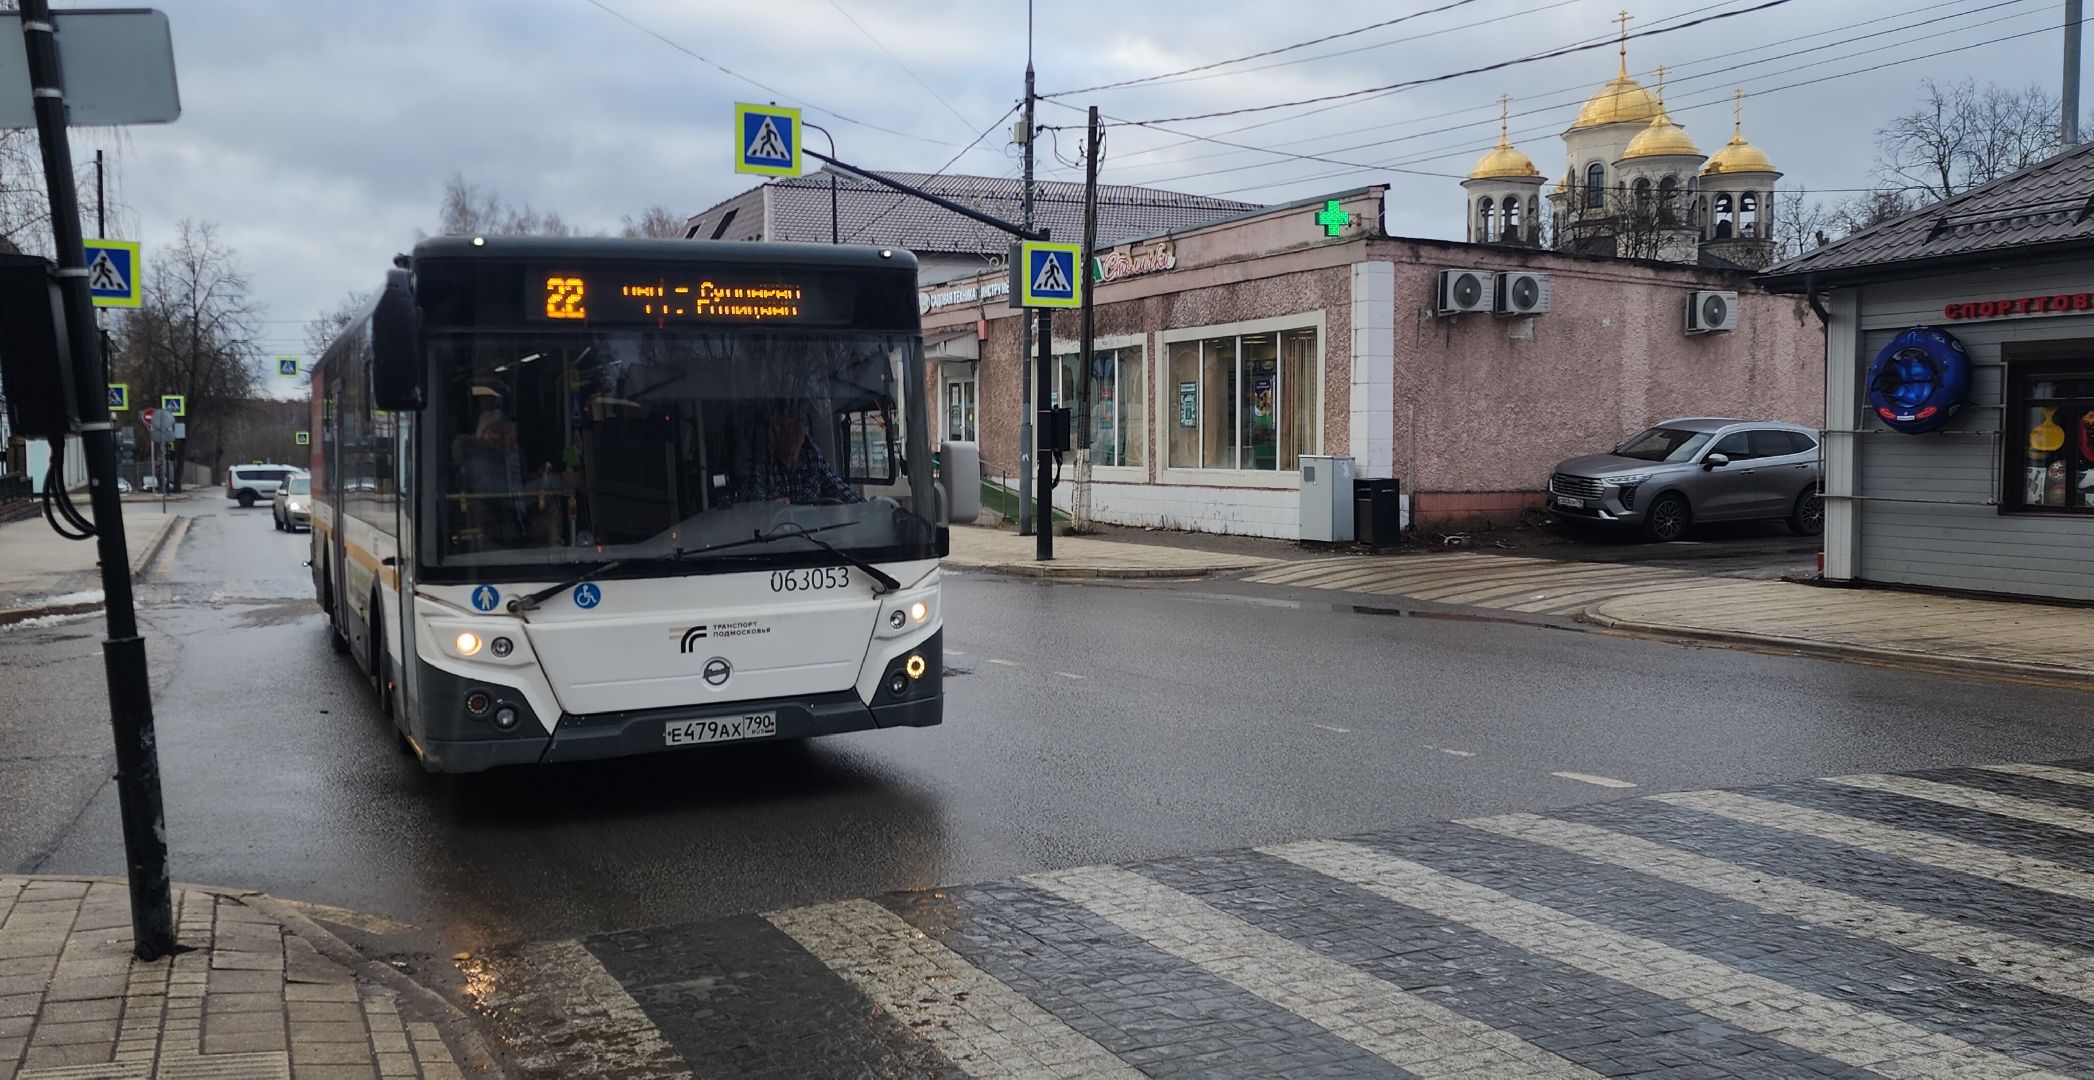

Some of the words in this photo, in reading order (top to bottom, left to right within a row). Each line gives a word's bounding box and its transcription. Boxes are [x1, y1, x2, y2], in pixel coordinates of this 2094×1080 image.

[547, 277, 584, 318] 22
[1944, 292, 2094, 319] СПОРТТОВ
[770, 566, 849, 592] 063053
[713, 621, 758, 630] ТРАНСПОРТ
[713, 627, 771, 637] ПОДМОСКОВЬЯ
